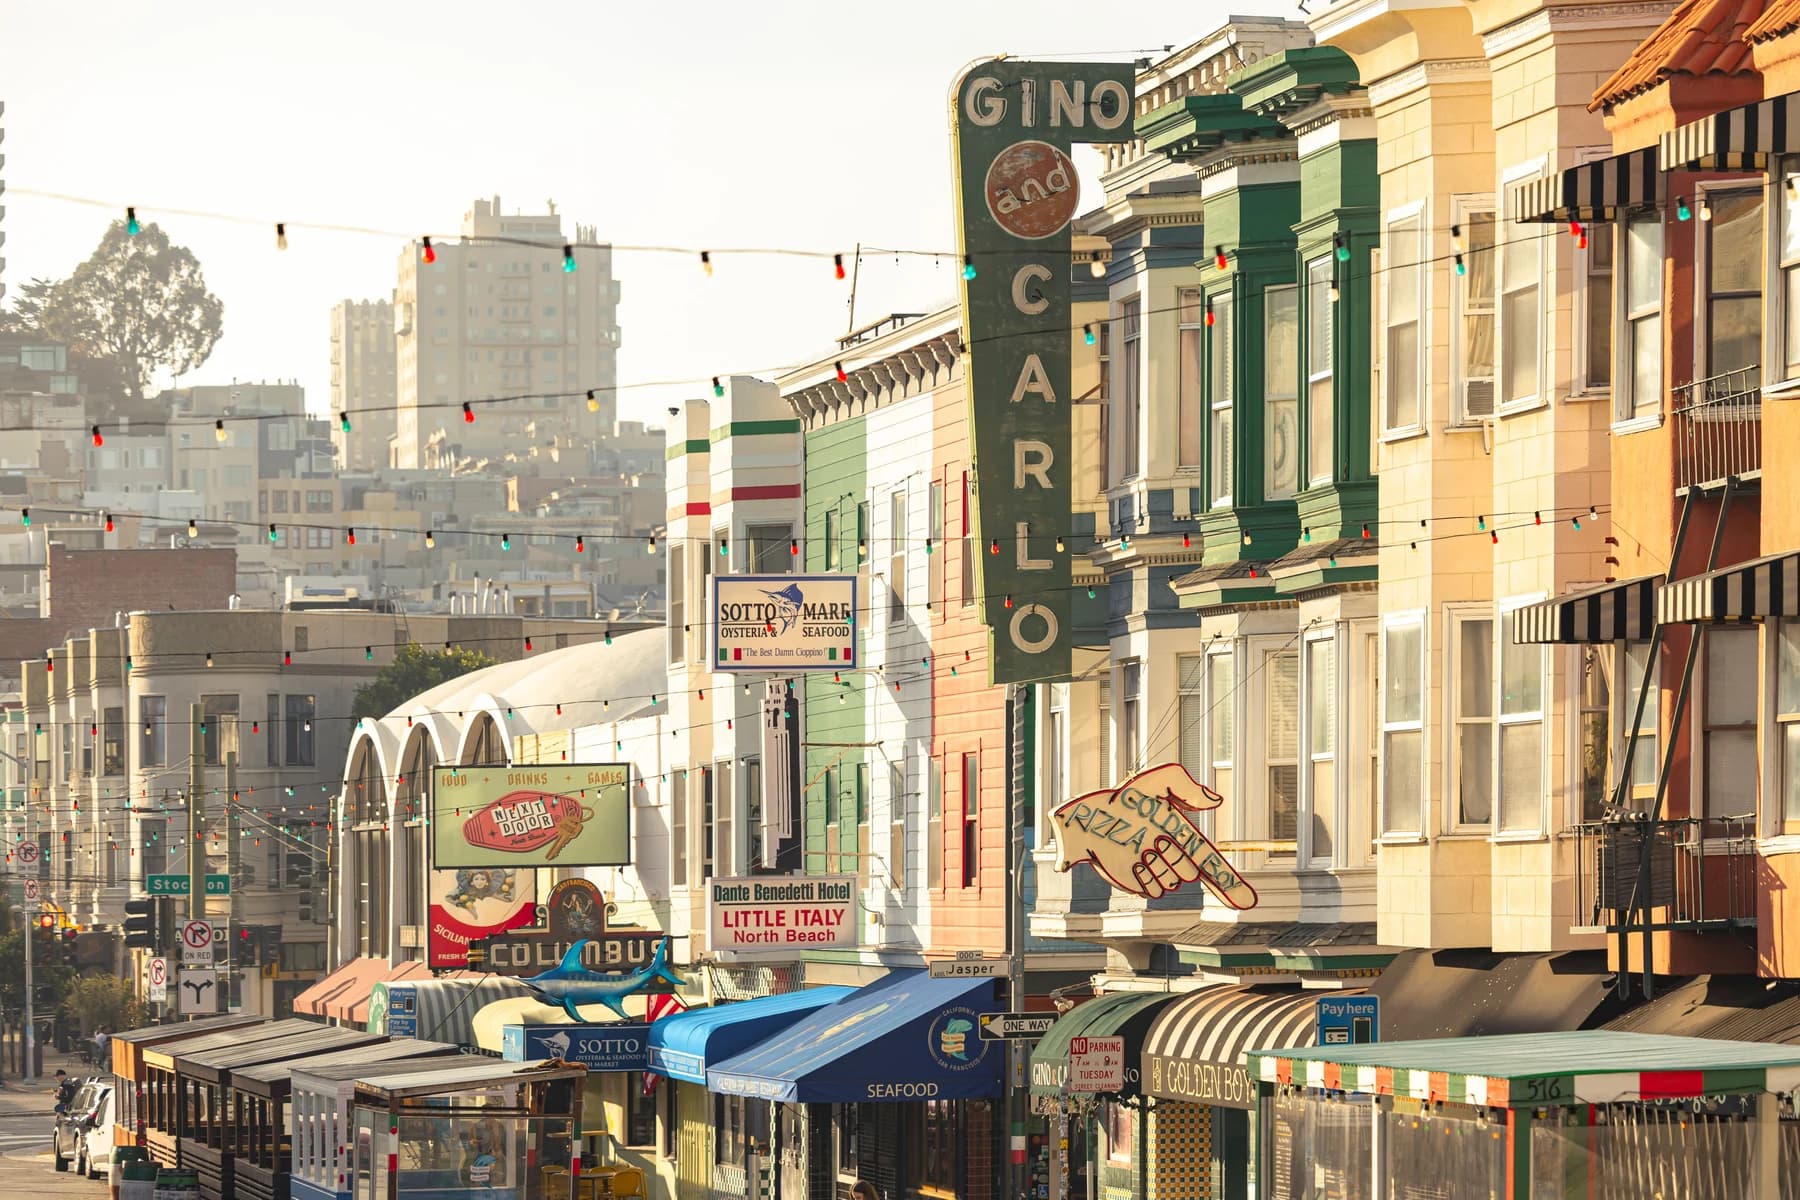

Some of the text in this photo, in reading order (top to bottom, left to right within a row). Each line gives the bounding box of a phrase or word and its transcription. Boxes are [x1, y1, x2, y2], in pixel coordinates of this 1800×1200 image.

[965, 75, 1130, 129] GINO
[996, 150, 1072, 214] and
[1009, 262, 1059, 655] CARLO
[720, 602, 849, 622] SOTTO MARE
[721, 626, 850, 639] OYSTERIA & SEAFOOD
[759, 647, 773, 658] Best
[774, 647, 794, 658] Damn
[441, 771, 624, 788] FOOD DRINKS GAMES
[494, 802, 546, 822] NEXT
[502, 815, 552, 835] DOOR
[1121, 787, 1243, 890] GOLDEN BOY
[153, 879, 226, 891] Stocon
[713, 881, 851, 903] Dante Benedetti Hotel
[723, 908, 846, 928] LITTLE ITALY
[733, 928, 836, 943] North Beach
[185, 951, 211, 960] ON RED
[438, 953, 460, 961] FRESH
[489, 939, 669, 967] COLUMBUS
[959, 952, 974, 960] 000
[948, 964, 995, 977] Jasper
[942, 1006, 977, 1017] CALIFORNIA
[1322, 1002, 1375, 1017] Pay here
[1003, 1019, 1051, 1032] ONE WAY
[578, 1038, 640, 1054] SOTTO
[1072, 1039, 1122, 1054] NO PARKING
[575, 1054, 606, 1062] OYSTERIA
[612, 1053, 642, 1061] SEAFOOD
[937, 1057, 982, 1072] SAN FRANCISCO
[1033, 1061, 1052, 1086] GINO
[1080, 1070, 1114, 1080] TUESDAY
[867, 1082, 939, 1098] SEAFOOD
[1167, 1060, 1222, 1099] GOLDEN
[1224, 1066, 1253, 1104] BOY
[1528, 1078, 1561, 1101] 516
